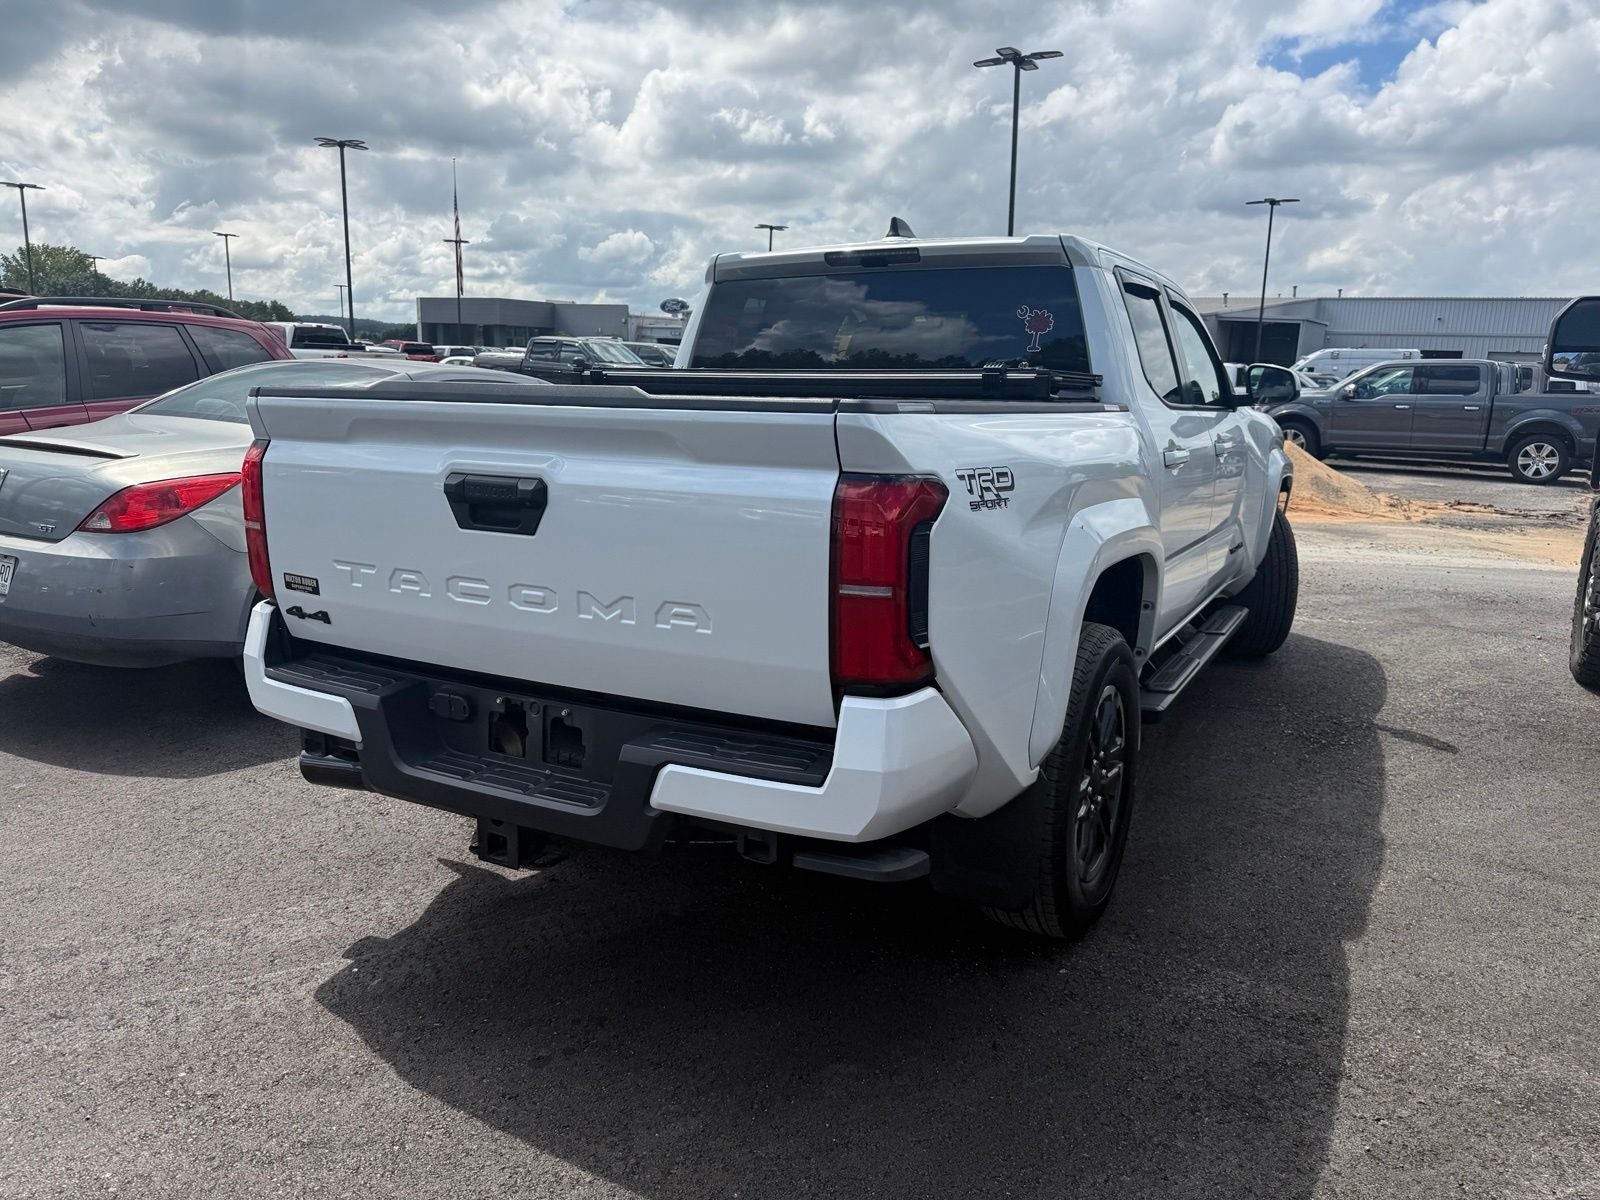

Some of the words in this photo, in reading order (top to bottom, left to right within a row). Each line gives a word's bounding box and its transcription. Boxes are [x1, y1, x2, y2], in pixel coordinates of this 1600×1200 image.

[664, 301, 682, 311] Ford
[955, 466, 1015, 500] TRD
[969, 498, 1010, 512] SPORT
[38, 524, 56, 533] GT
[333, 560, 712, 633] TACOMA
